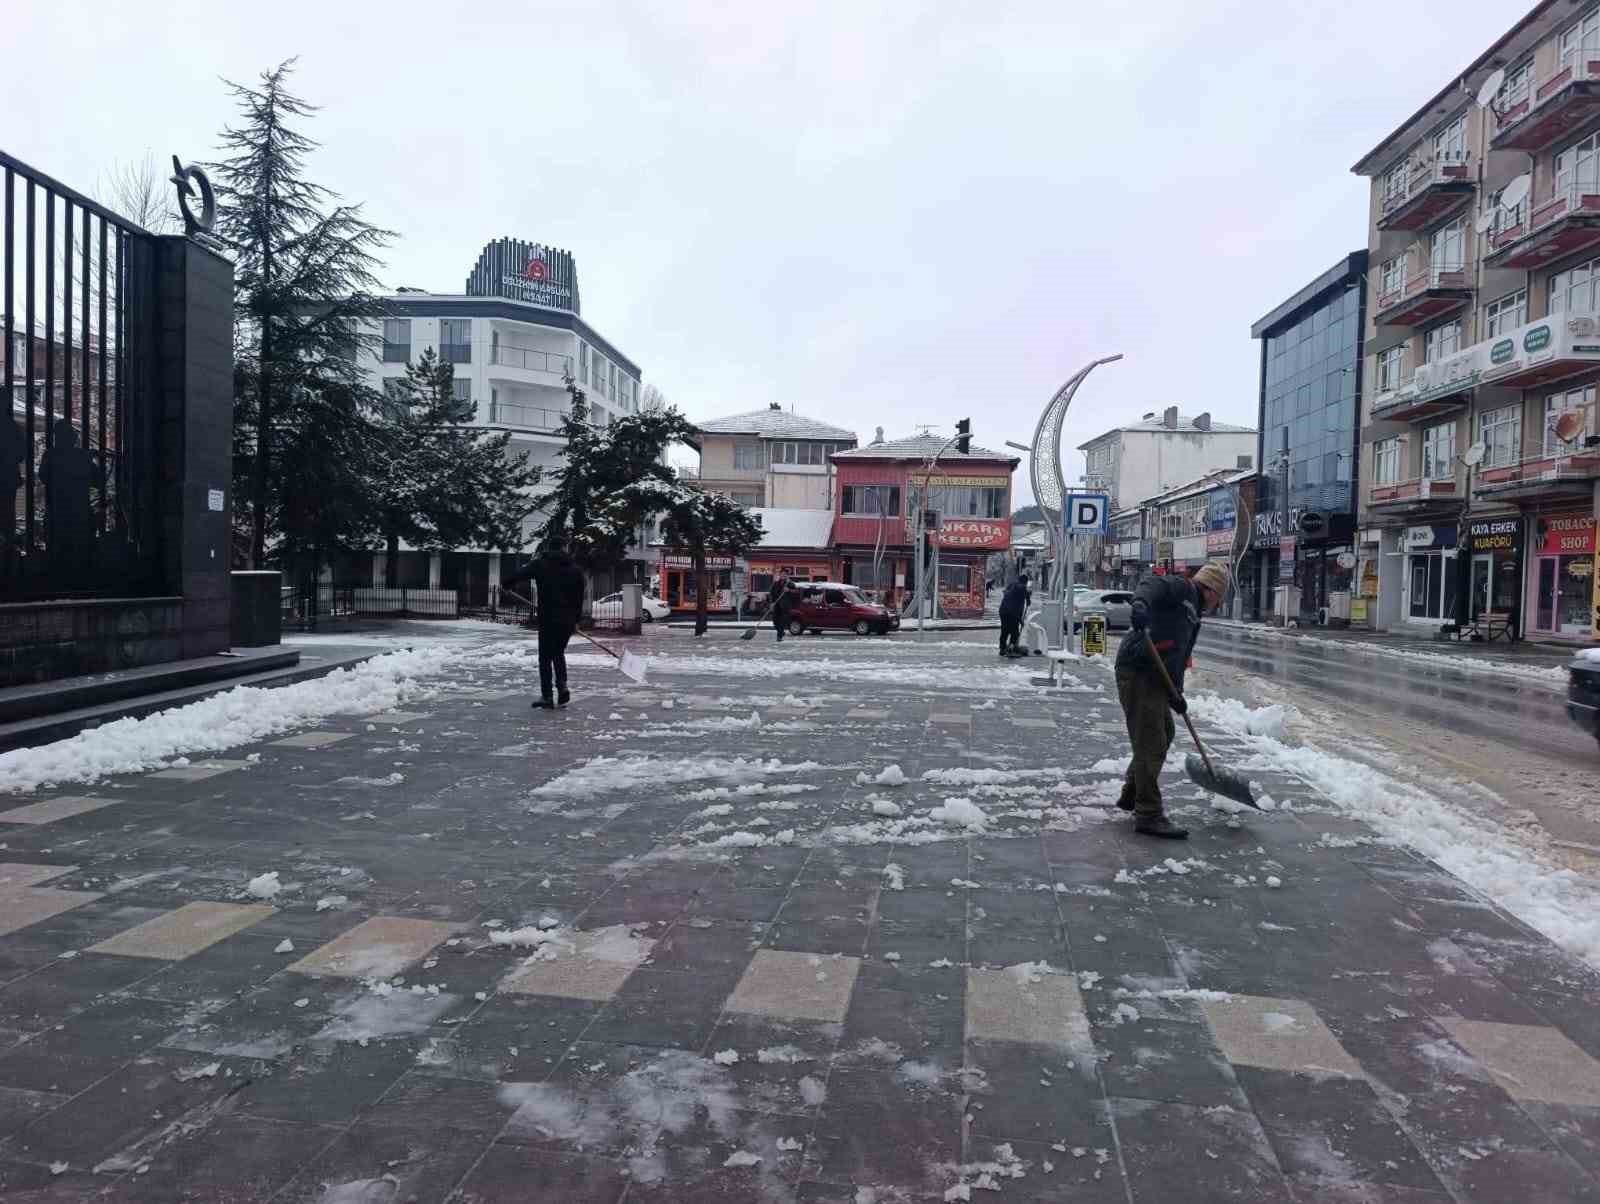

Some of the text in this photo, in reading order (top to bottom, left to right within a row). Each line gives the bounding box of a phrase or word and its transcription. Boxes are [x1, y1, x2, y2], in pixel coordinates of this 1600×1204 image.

[1078, 503, 1098, 525] D
[928, 521, 1002, 537] NKARA
[1471, 521, 1517, 535] KAYA ERKEK
[938, 535, 993, 545] KEBAP
[1560, 535, 1589, 549] SHOP
